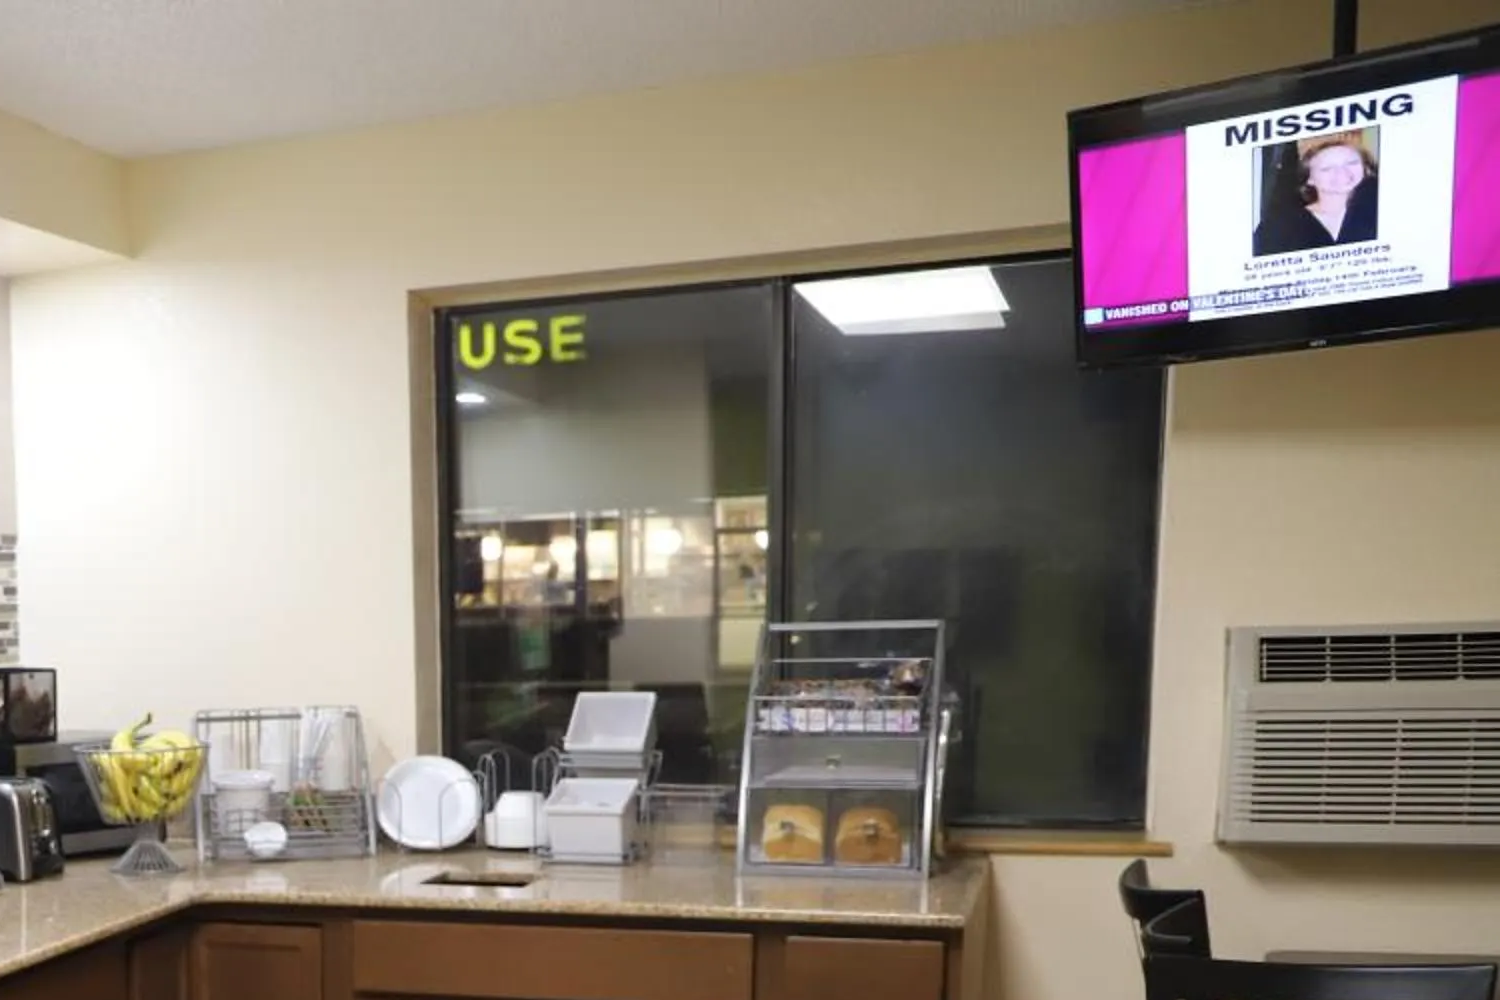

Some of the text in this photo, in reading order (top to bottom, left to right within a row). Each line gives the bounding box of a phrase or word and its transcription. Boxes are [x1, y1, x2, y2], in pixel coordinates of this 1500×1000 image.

[1225, 93, 1414, 147] MISSING
[1244, 257, 1303, 271] Loretta
[1309, 244, 1391, 263] Saunders
[1105, 302, 1167, 320] VANISHED
[1170, 299, 1189, 312] ON
[459, 314, 587, 370] USE
